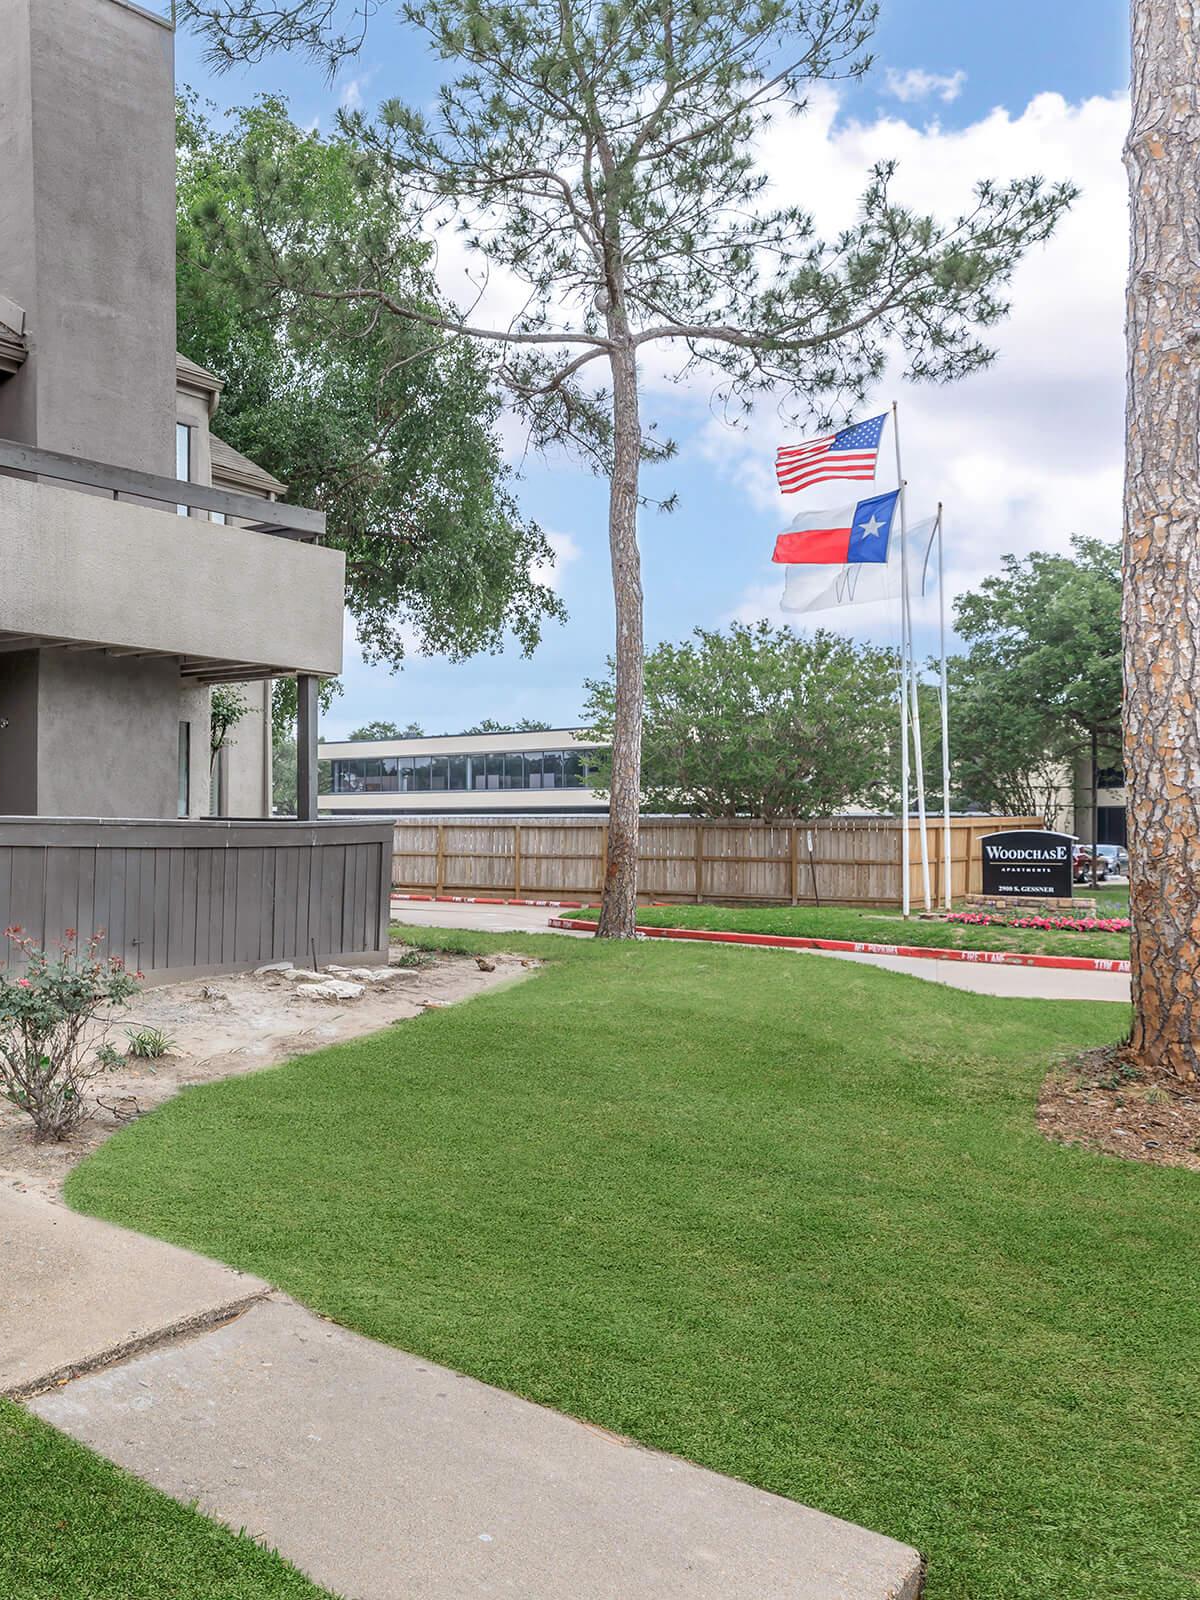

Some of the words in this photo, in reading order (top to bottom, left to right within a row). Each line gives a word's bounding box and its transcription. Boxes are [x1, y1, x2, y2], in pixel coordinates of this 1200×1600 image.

[985, 846, 1067, 860] WOODCHASE
[960, 951, 980, 961] FIRE
[1094, 959, 1112, 969] TOW
